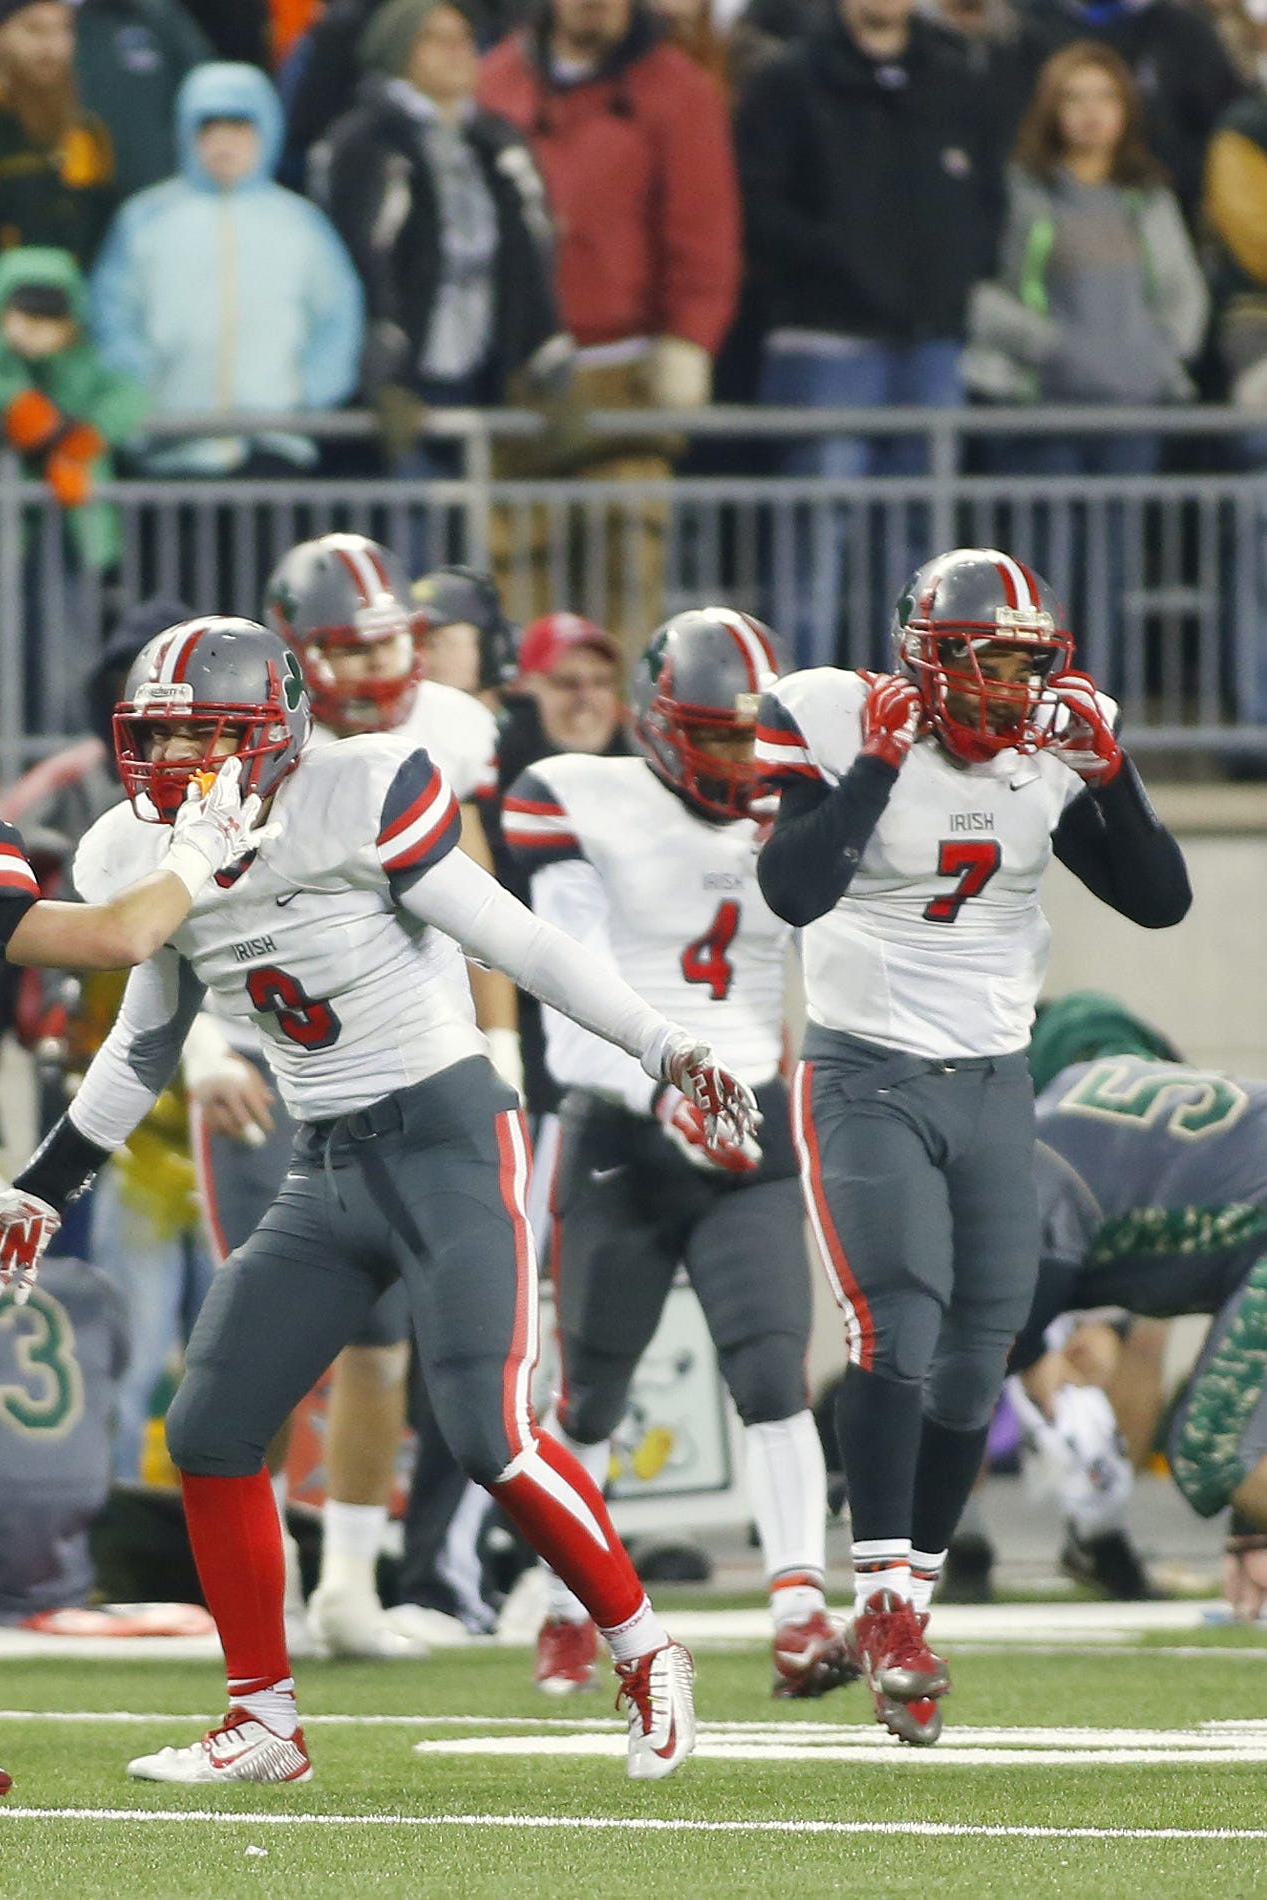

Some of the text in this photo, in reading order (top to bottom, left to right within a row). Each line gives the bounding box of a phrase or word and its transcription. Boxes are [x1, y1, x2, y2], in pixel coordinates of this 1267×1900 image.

[949, 812, 995, 832] IRISH
[923, 839, 1002, 923] 7
[231, 934, 277, 961] IRISH
[680, 896, 743, 1001] 4
[245, 964, 342, 1051] 3
[1058, 1063, 1250, 1142] 5
